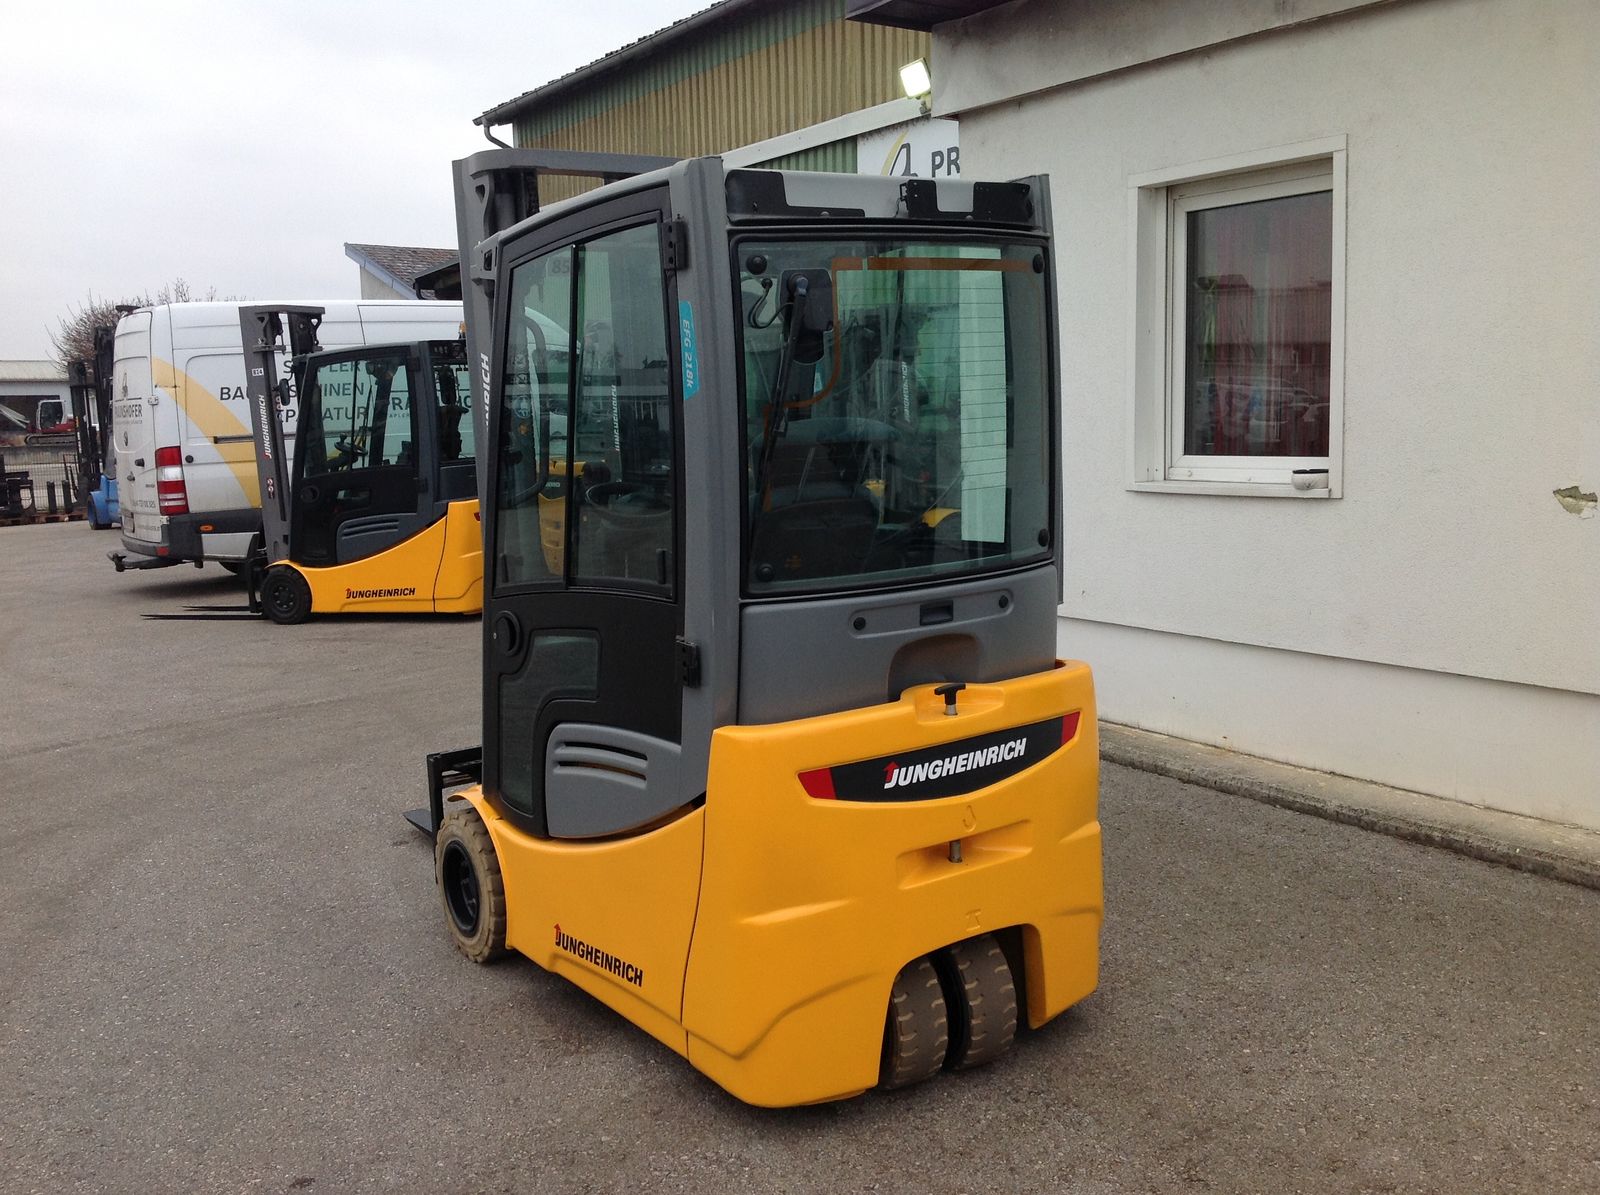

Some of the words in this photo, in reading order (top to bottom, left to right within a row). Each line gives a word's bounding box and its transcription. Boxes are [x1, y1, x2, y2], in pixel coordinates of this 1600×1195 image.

[552, 260, 570, 274] 85
[683, 319, 692, 347] EFG
[220, 382, 364, 401] BASINEN
[259, 394, 272, 459] JUNGHEINRICH
[345, 587, 416, 599] JUNGHEINRICH
[884, 737, 1027, 789] JUNGHEINRICH
[555, 927, 643, 988] JUNGHEINRICH
